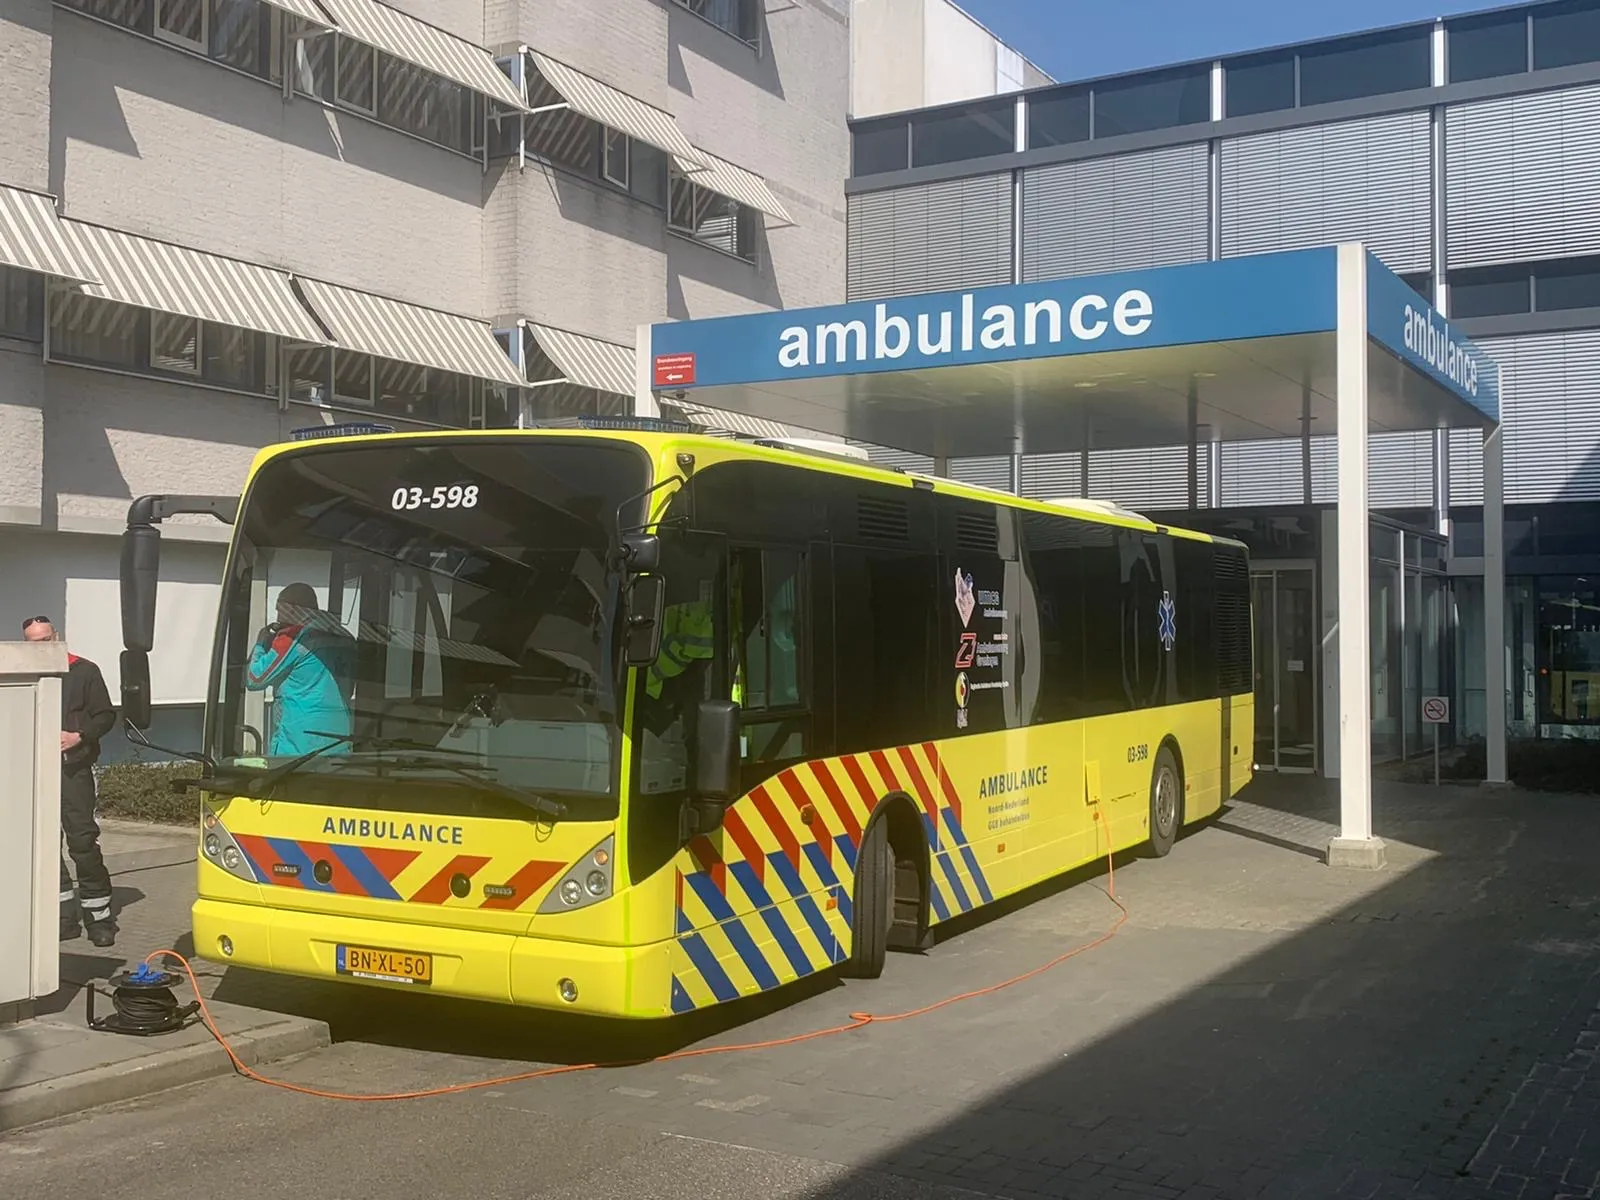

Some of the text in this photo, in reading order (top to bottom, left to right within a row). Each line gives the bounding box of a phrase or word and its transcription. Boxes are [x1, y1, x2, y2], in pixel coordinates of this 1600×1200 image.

[778, 289, 1153, 368] ambulance
[1404, 304, 1477, 397] ambulance
[391, 485, 479, 510] 03-598
[1127, 743, 1148, 763] 03-598
[979, 765, 1048, 799] AMBULANCE
[322, 816, 463, 845] AMBULANCE
[350, 950, 425, 976] BN-XL-50
